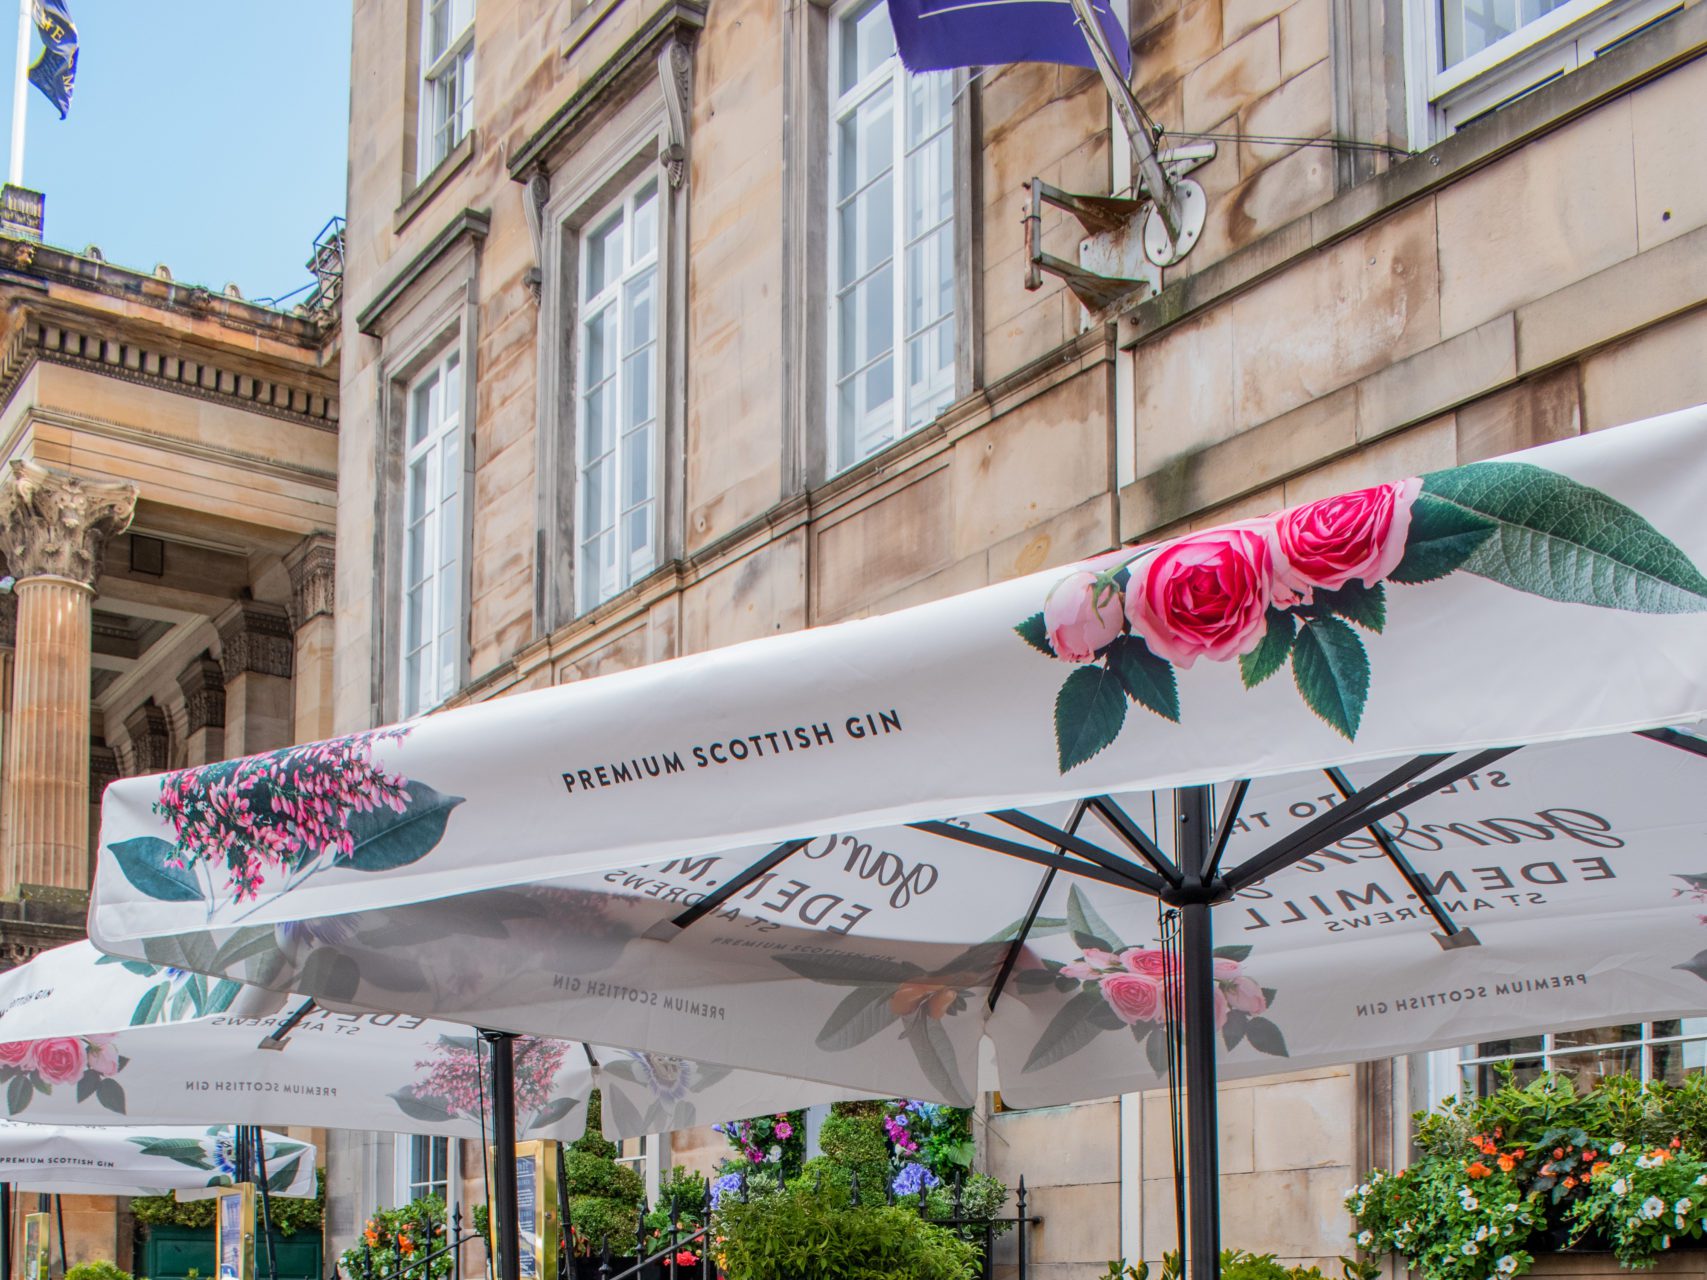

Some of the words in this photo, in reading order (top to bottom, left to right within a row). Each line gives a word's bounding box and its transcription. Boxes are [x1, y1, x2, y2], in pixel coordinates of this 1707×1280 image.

[562, 751, 685, 793] PREMIUM
[692, 722, 834, 768] SCOTTISH
[845, 709, 902, 739] GIN
[0, 1156, 45, 1165] PREMIUM
[48, 1157, 94, 1167] SCOTTISH
[97, 1160, 115, 1168] GIN
